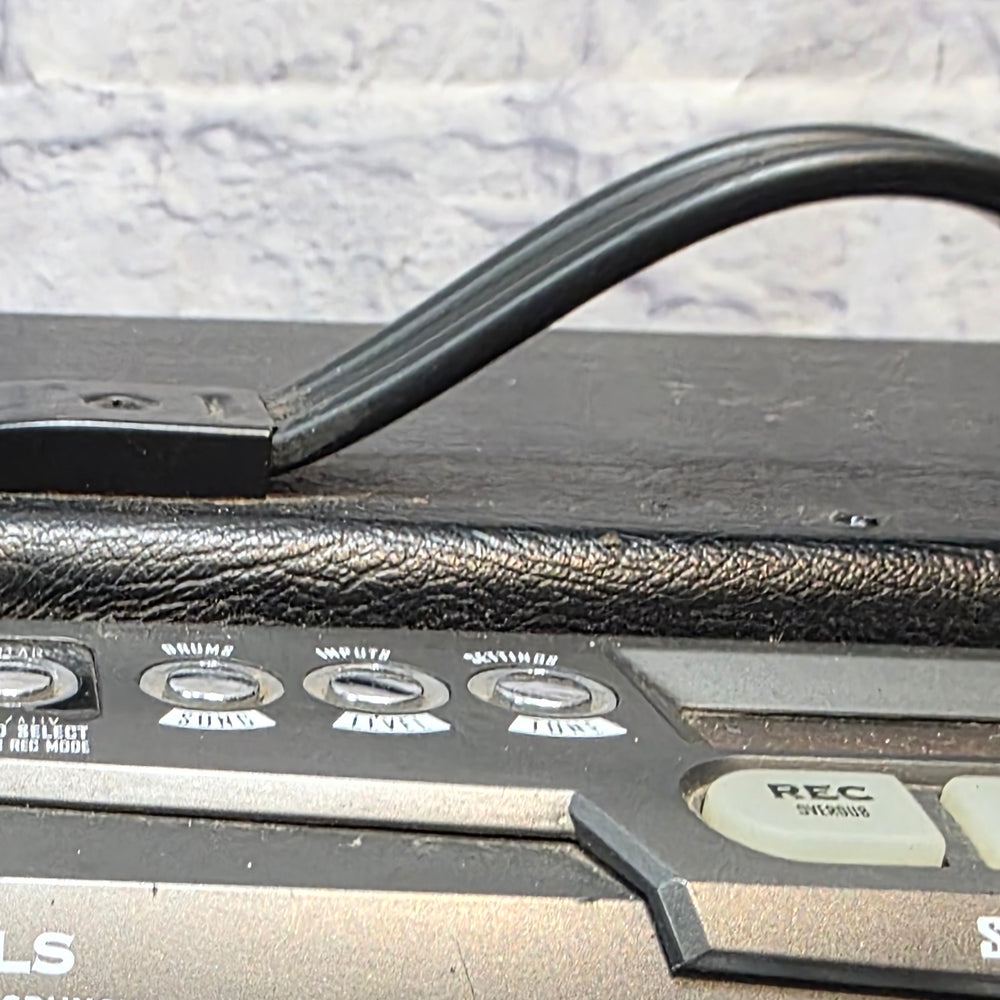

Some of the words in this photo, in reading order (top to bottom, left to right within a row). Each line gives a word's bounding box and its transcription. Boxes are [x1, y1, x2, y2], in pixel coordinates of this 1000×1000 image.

[17, 723, 89, 740] SELECT
[45, 739, 91, 754] MODE
[767, 783, 875, 801] REC
